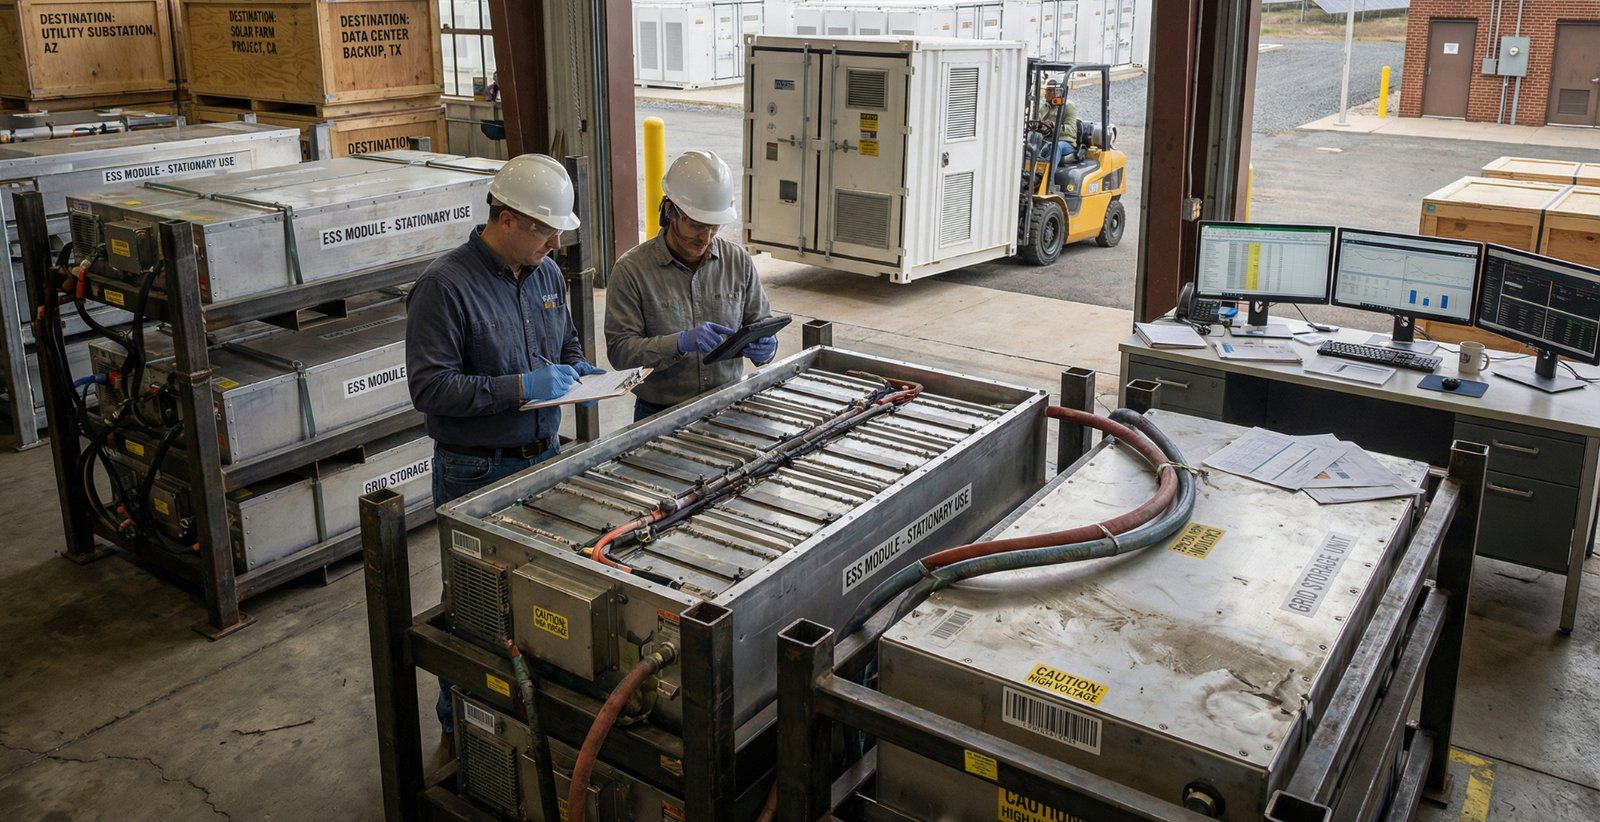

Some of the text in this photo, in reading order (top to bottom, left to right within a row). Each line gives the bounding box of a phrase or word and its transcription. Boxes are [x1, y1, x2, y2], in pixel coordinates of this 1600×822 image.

[40, 12, 115, 25] DESTINATION:
[229, 10, 276, 23] DESTINATION:
[340, 13, 410, 27] DESTINATION:
[42, 24, 156, 39] UTILITY SUBSTATION,
[230, 26, 275, 39] SOLAR FARM
[342, 28, 409, 43] DATA CENTER
[44, 42, 59, 54] AZ
[232, 41, 277, 56] PROJECT, CA
[343, 44, 402, 59] BACKUP, TX
[105, 171, 123, 182] ESS
[125, 166, 160, 180] MODULE
[168, 159, 217, 174] STATIONARY
[219, 156, 235, 168] USE
[323, 230, 343, 245] ESS
[345, 221, 387, 241] MODULE
[395, 209, 451, 231] STATIONARY
[453, 205, 471, 220] USE
[347, 366, 406, 395] ESS MODULE
[365, 477, 388, 494] GRID
[389, 460, 430, 486] STORAGE
[846, 562, 863, 588] ESS
[865, 536, 900, 575] MODULE
[907, 500, 954, 545] STATIONARY
[954, 489, 969, 512] USE
[1288, 534, 1351, 613] GRID STORAGE UNIT
[1028, 674, 1098, 703] HIGH VOLTAGE
[1036, 666, 1104, 696] CAUTION:
